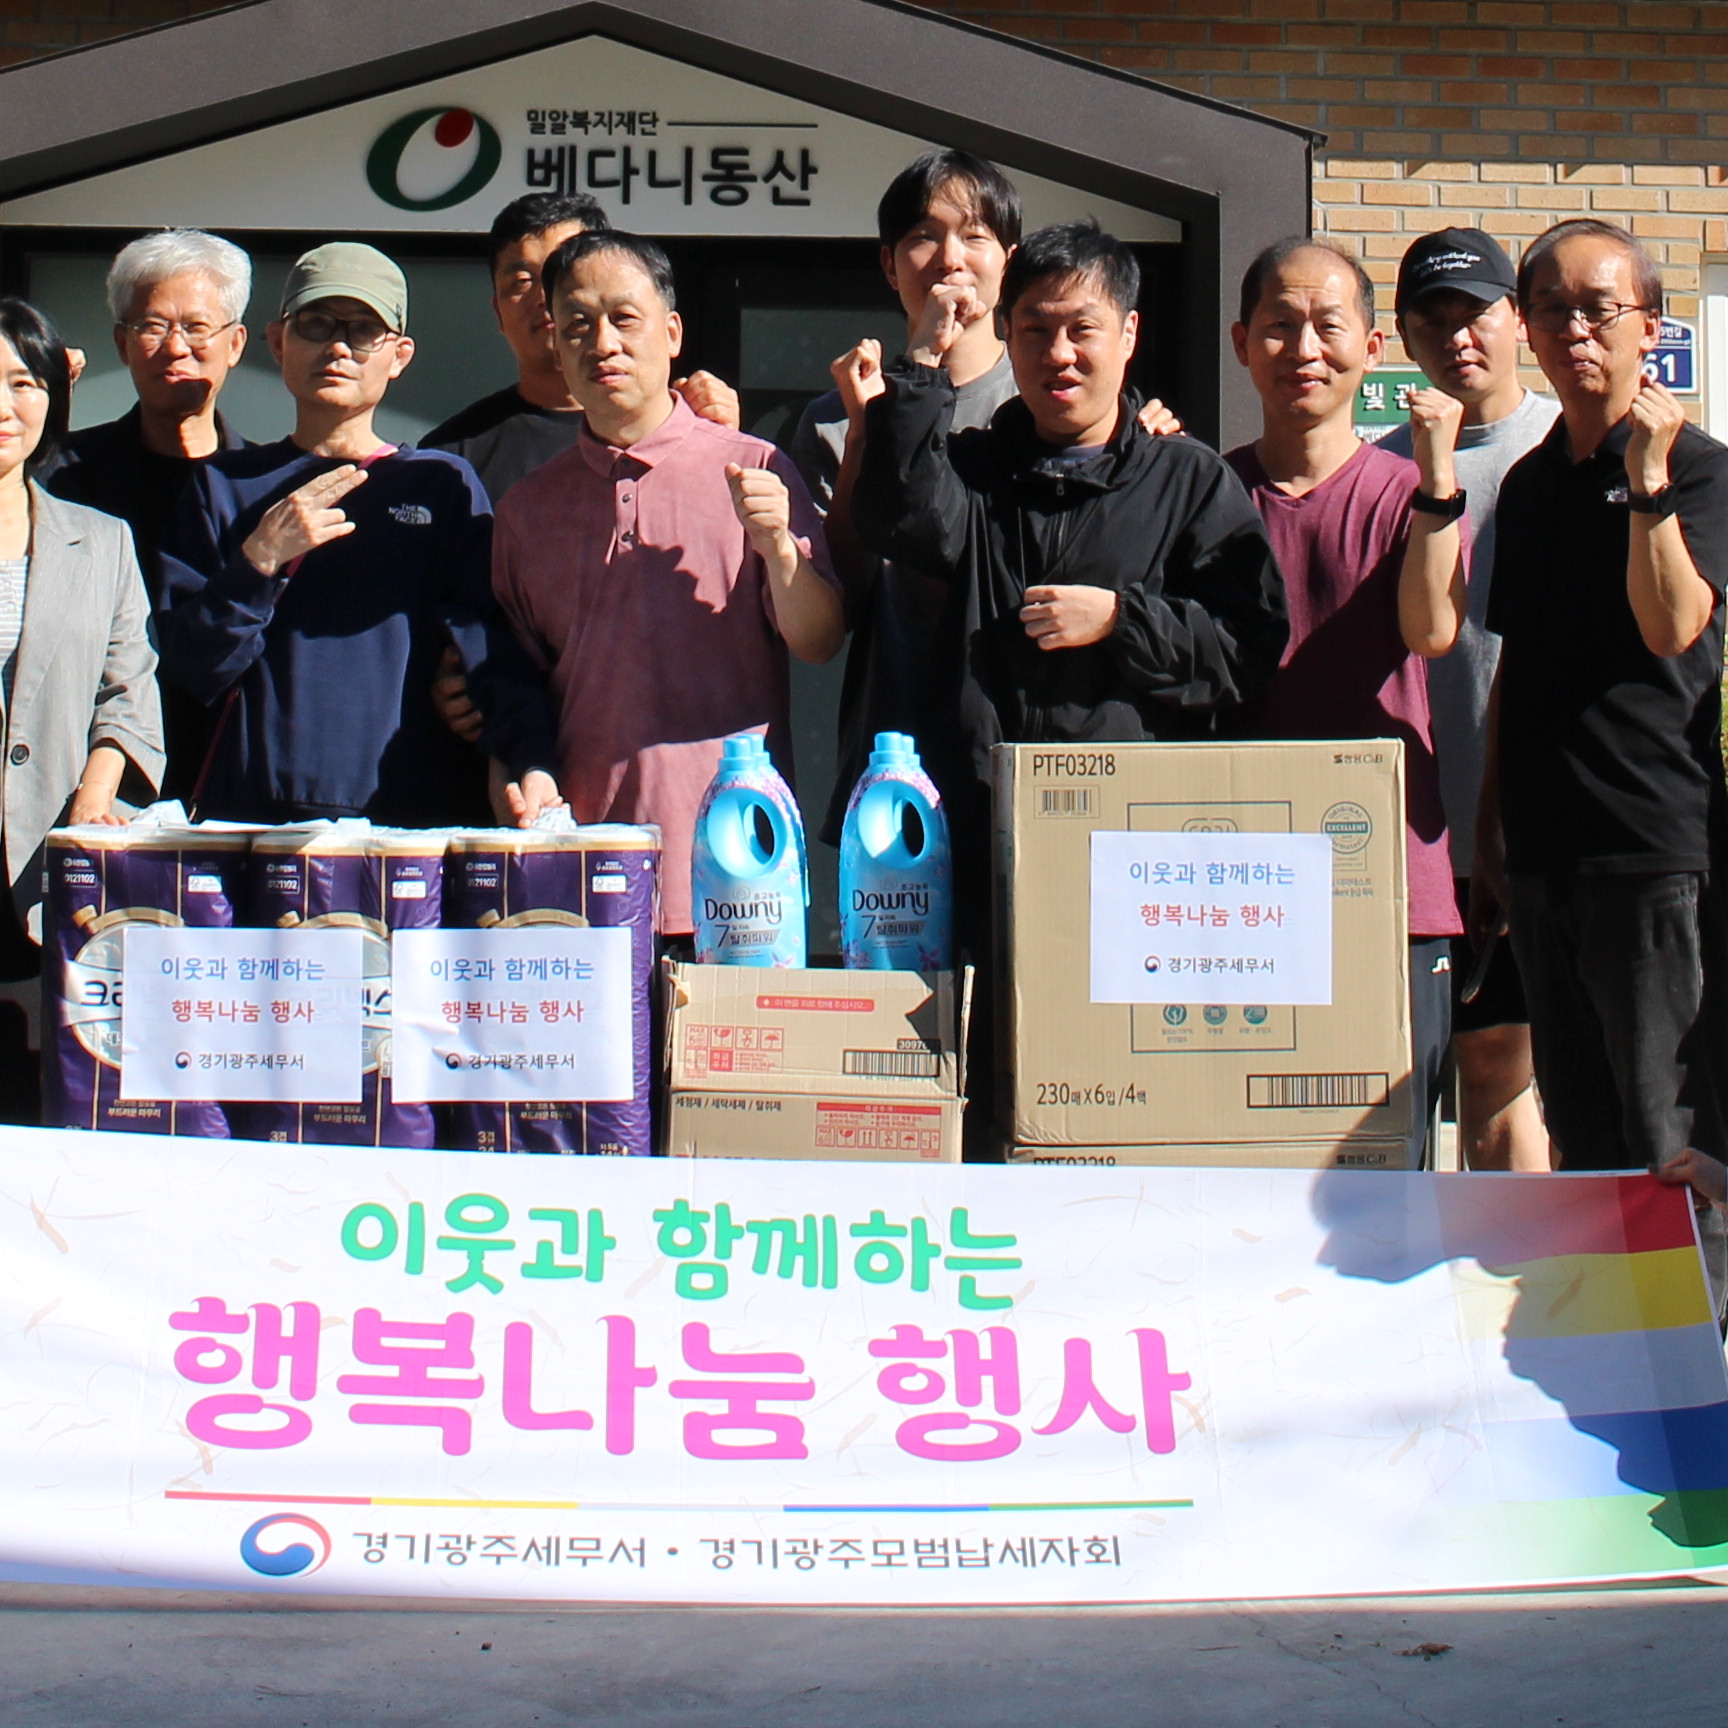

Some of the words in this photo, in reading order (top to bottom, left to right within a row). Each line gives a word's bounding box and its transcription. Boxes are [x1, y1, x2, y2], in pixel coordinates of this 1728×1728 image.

[527, 109, 659, 136] 밀알복지재단
[526, 144, 818, 206] 베다니동산
[1033, 753, 1116, 777] PTF03218
[1327, 823, 1367, 832] EXCELLENT
[1130, 861, 1196, 885] 이웃과
[1206, 861, 1295, 885] 함께하는
[705, 898, 782, 925] Downy
[853, 889, 929, 917] Downy
[861, 915, 876, 939] 7
[1141, 904, 1231, 928] 행복나눔
[1240, 904, 1285, 928] 행사
[715, 924, 730, 948] 7
[160, 957, 229, 981] 이웃과
[237, 957, 325, 982] 함께하는
[430, 957, 496, 981] 이웃과
[505, 957, 594, 982] 함께하는
[1168, 956, 1274, 975] 경기광주세무서
[171, 1000, 261, 1024] 행복나눔
[270, 1000, 315, 1024] 행사
[442, 1000, 531, 1024] 행복나눔
[539, 1000, 585, 1024] 행사
[199, 1053, 304, 1070] 경기광주세무서
[468, 1053, 575, 1070] 경기광주세무서
[341, 1192, 617, 1295] 이웃과
[652, 1198, 1023, 1311] 함께하는
[168, 1296, 817, 1461] 행복나눔
[867, 1323, 1193, 1463] 행사
[352, 1531, 646, 1570] 경기광주세무서
[698, 1535, 1122, 1571] 경기광주모범납세자회
